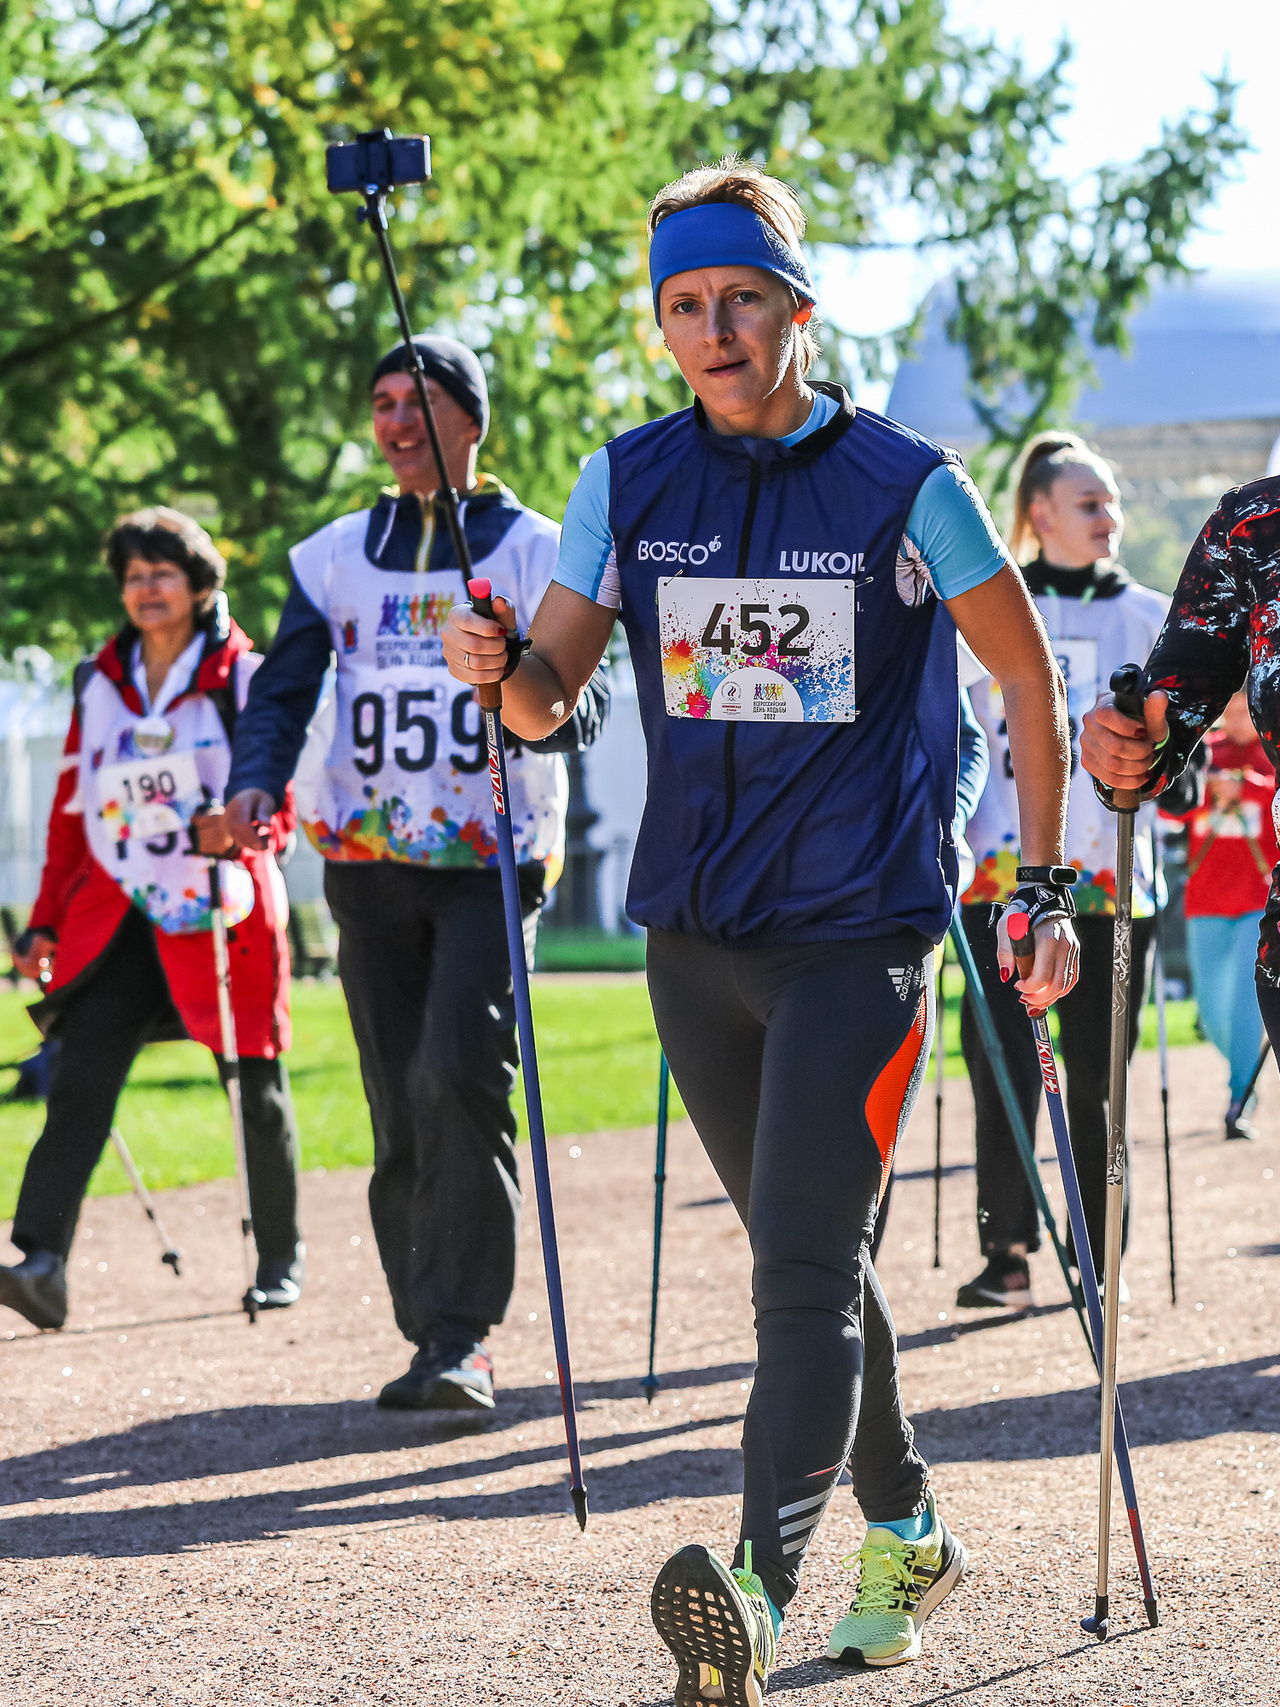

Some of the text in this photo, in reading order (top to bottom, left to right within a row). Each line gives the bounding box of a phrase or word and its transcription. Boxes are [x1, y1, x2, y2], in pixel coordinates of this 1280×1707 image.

[637, 539, 709, 565] BOSCO
[778, 550, 866, 575] LUKOIL
[701, 602, 811, 657] 452
[352, 689, 489, 777] 959
[122, 769, 177, 803] 190
[899, 964, 914, 1001] adidas
